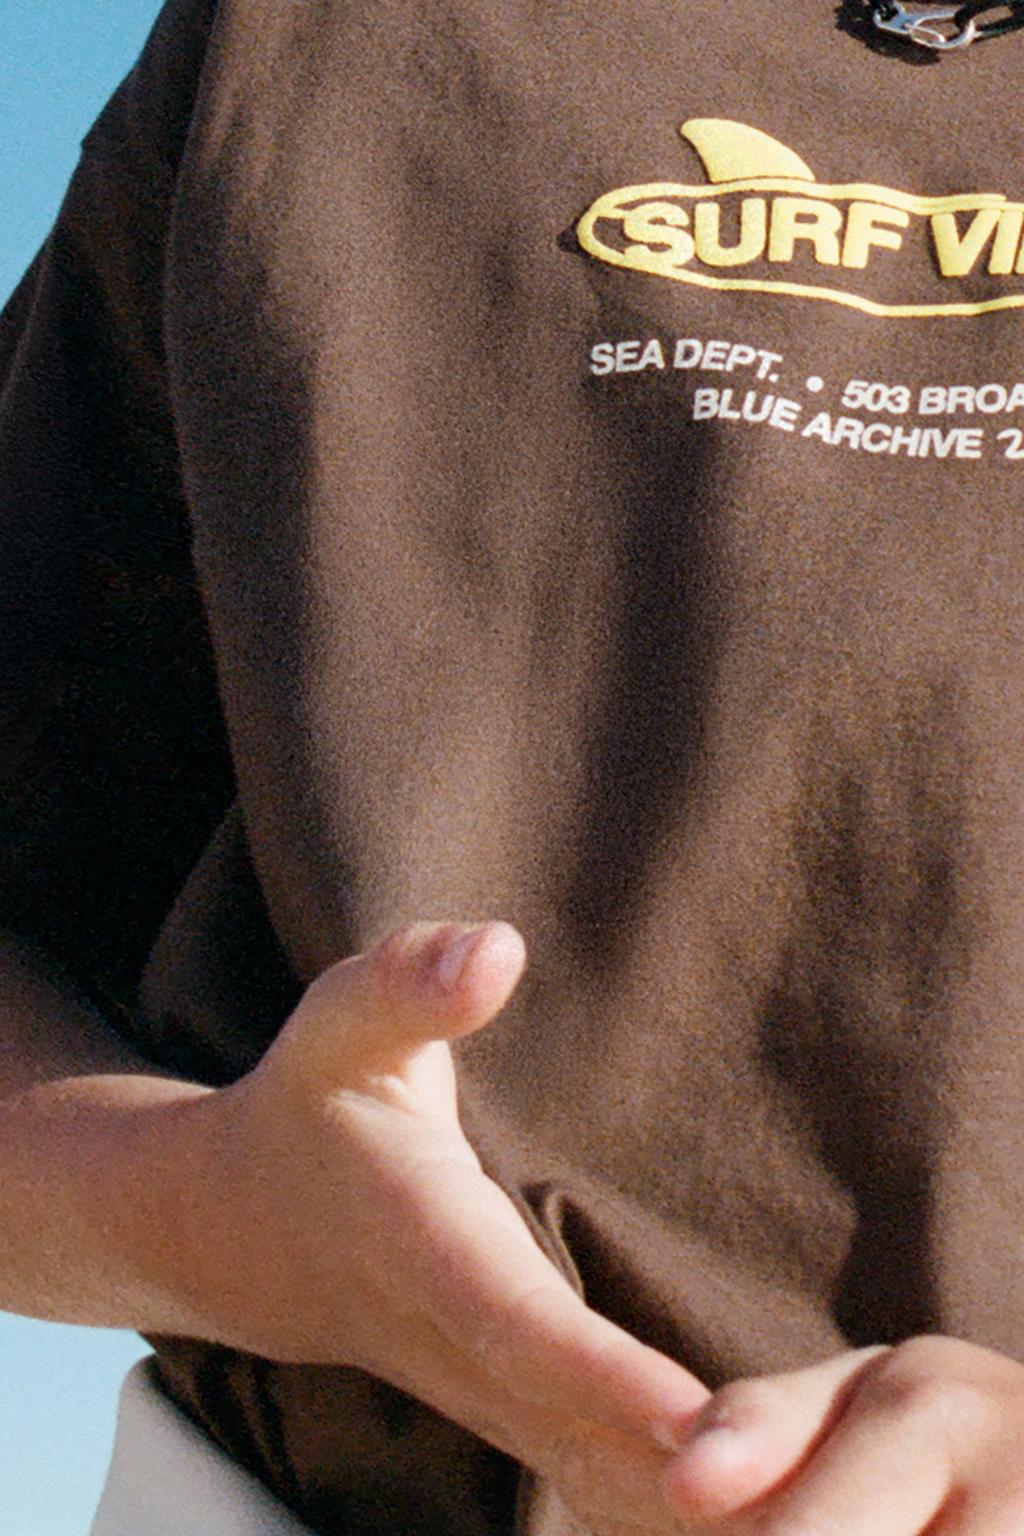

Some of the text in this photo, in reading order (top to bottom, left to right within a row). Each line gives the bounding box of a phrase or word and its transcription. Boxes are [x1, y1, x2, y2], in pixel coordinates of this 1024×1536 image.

[622, 197, 909, 269] SURF
[591, 339, 665, 375] SEA
[673, 338, 783, 383] DEPT.
[841, 380, 910, 413] 503
[693, 388, 802, 431] BLUE
[801, 412, 984, 458] ARCHIVE
